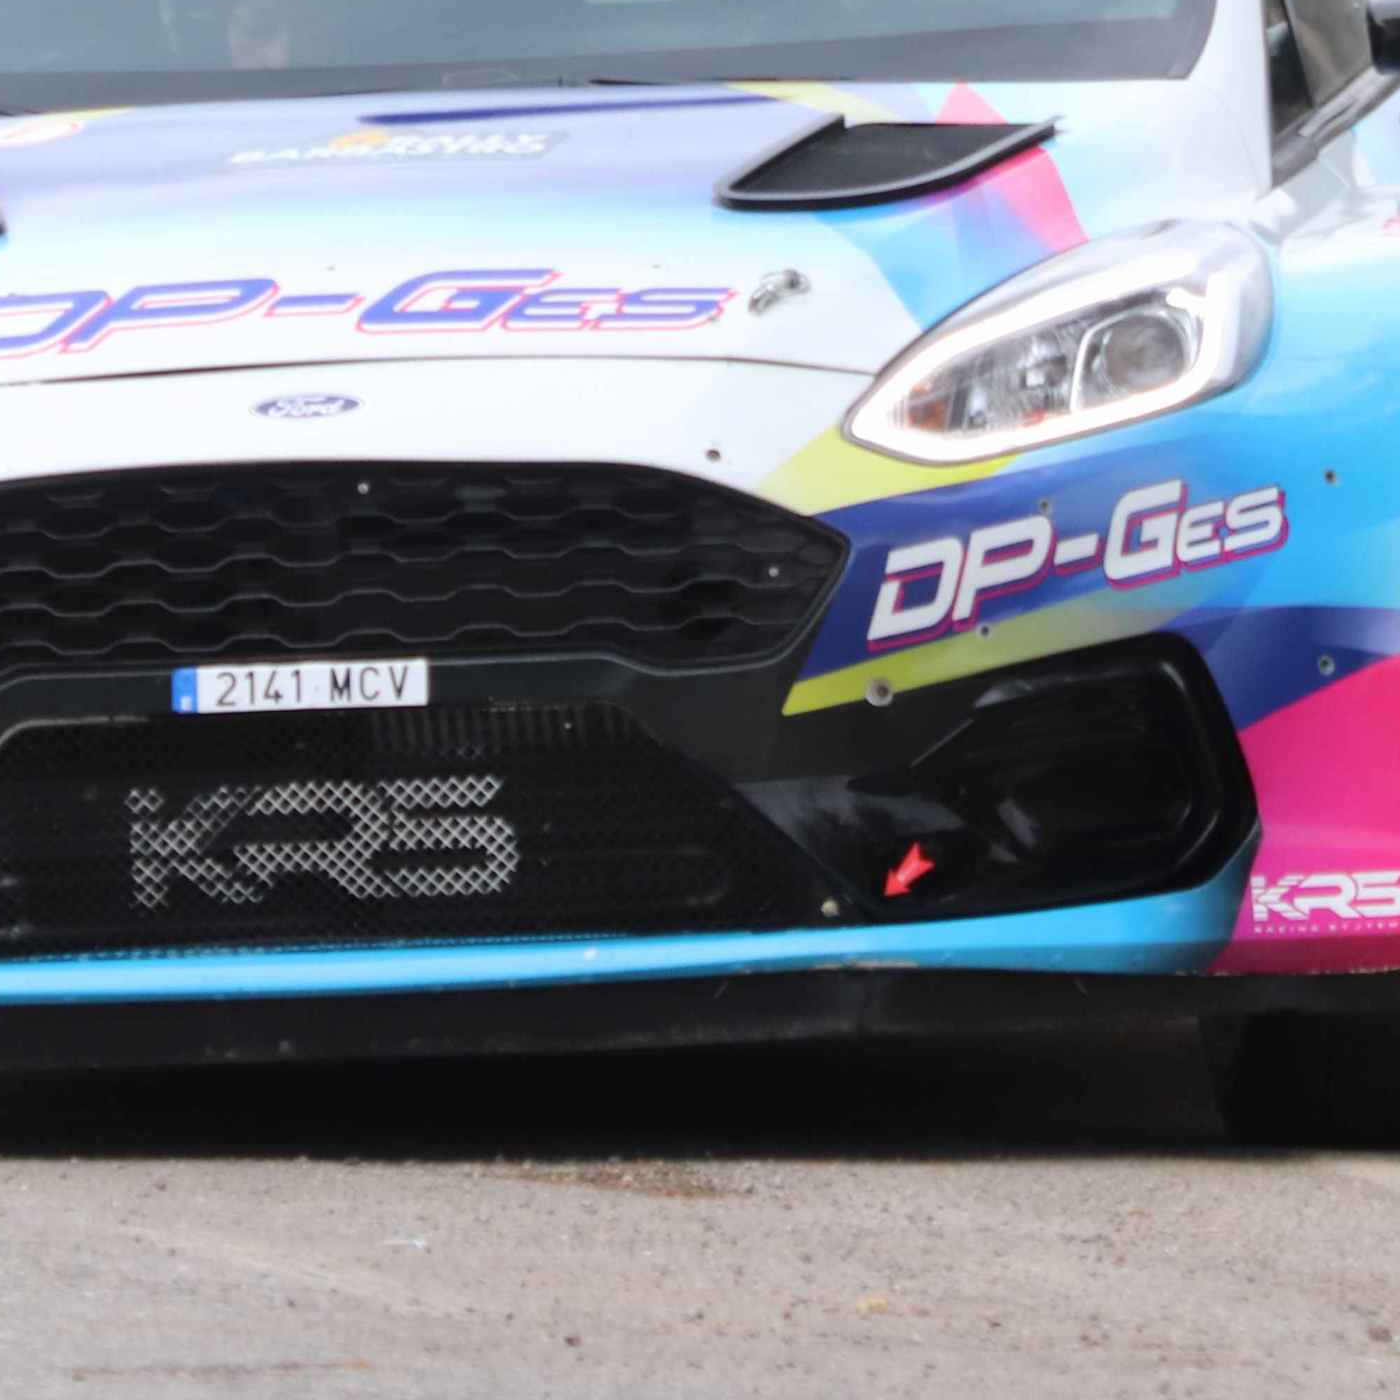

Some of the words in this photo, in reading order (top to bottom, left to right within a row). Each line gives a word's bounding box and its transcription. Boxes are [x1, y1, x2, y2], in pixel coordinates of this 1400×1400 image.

[216, 669, 301, 707] 2141
[330, 665, 408, 703] MCV
[126, 775, 519, 907] KRS
